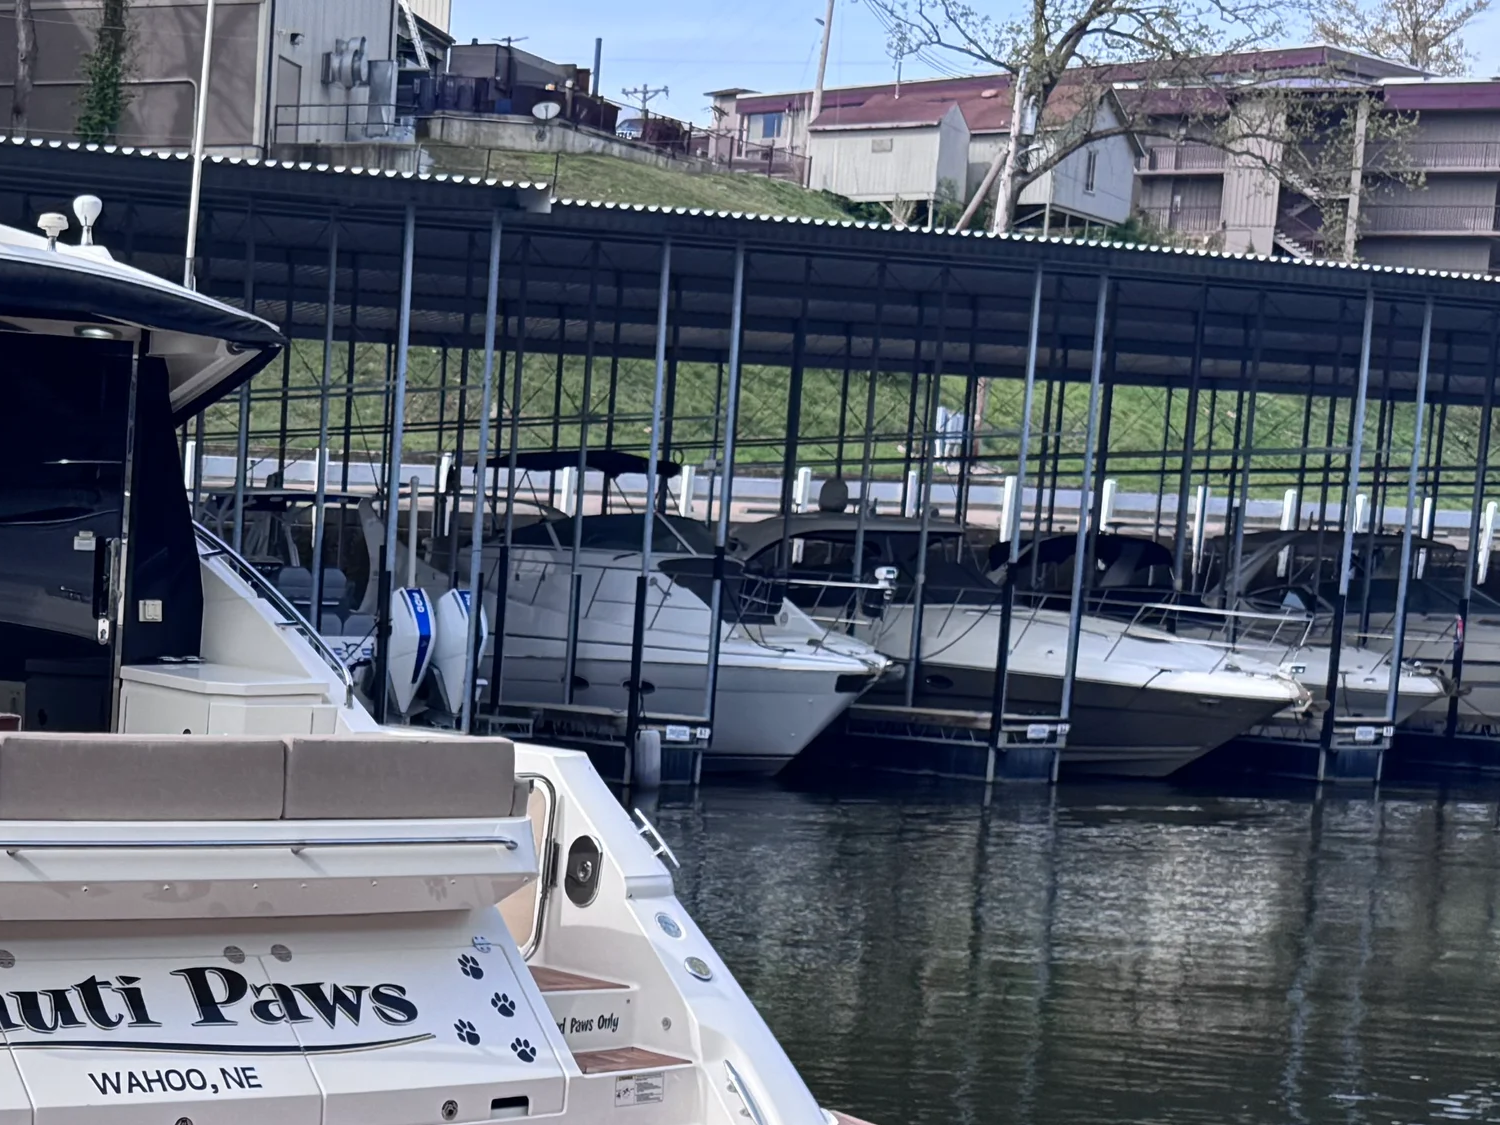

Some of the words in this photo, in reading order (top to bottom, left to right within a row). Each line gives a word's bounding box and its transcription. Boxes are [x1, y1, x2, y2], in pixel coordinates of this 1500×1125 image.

[169, 966, 419, 1029] Paws
[570, 1017, 594, 1034] Paws
[597, 1012, 619, 1033] Only
